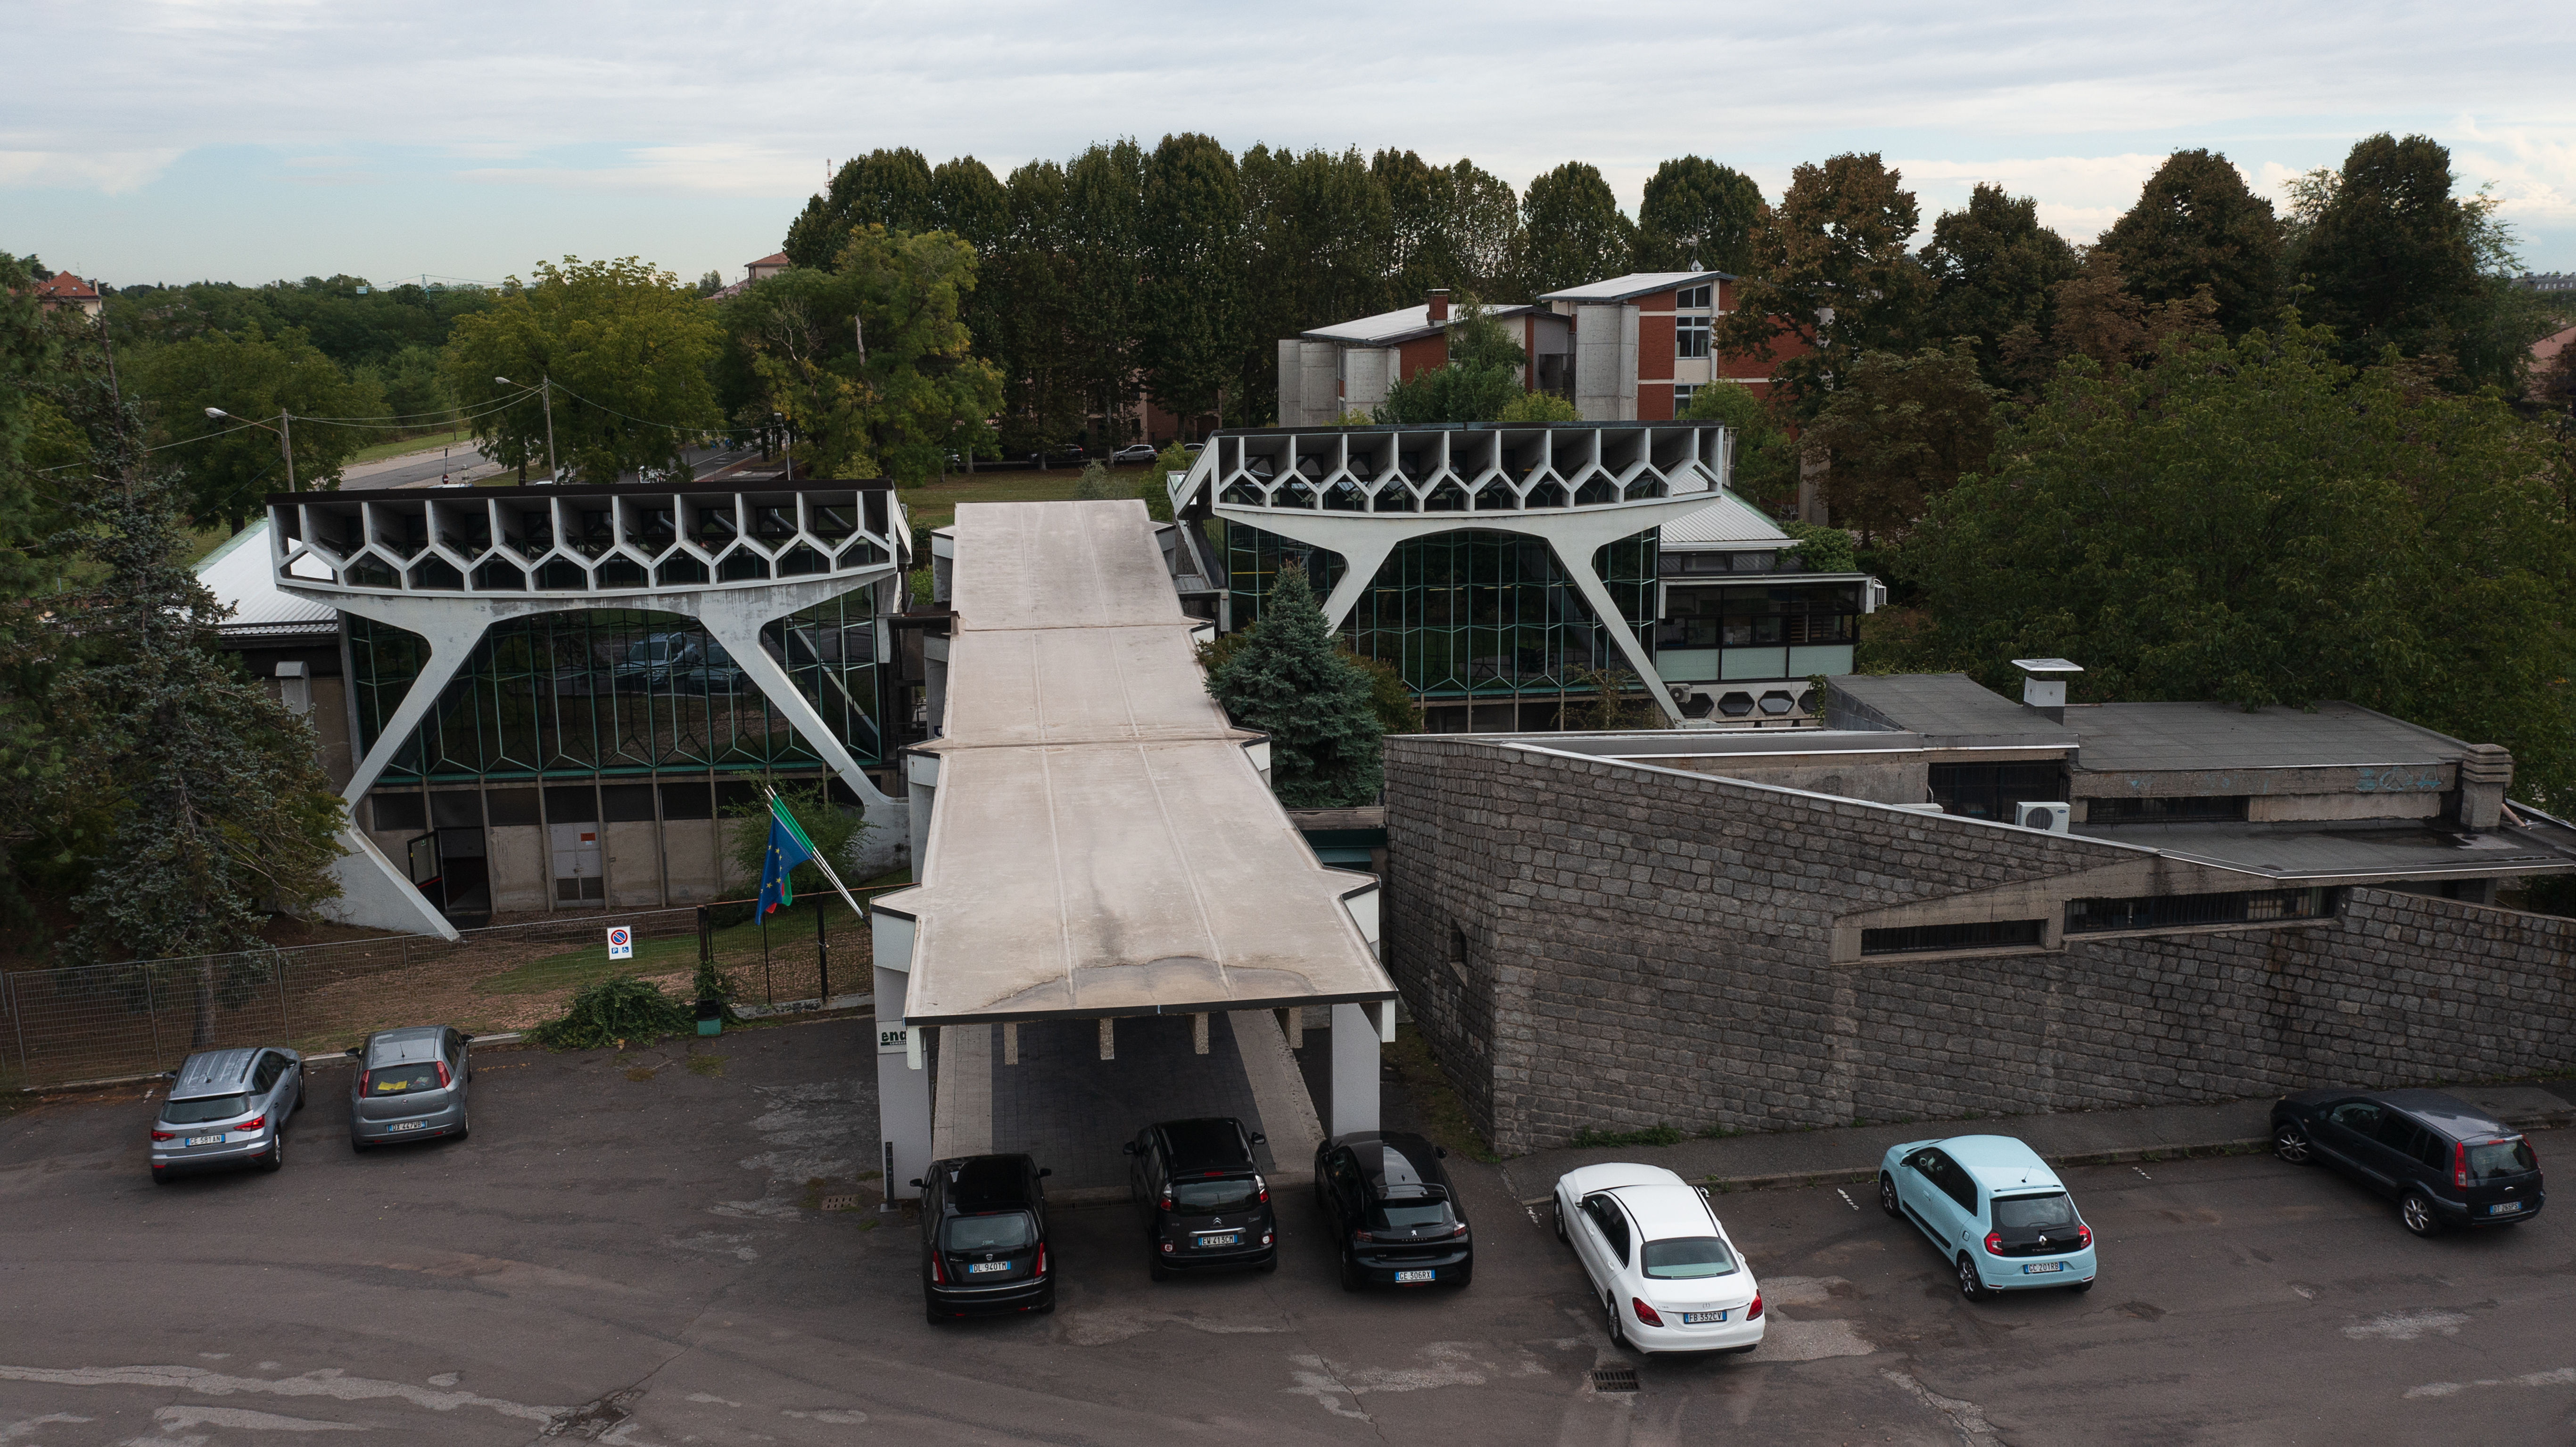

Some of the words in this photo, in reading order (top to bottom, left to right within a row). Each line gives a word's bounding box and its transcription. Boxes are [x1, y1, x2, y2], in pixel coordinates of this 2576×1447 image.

[882, 1031, 906, 1042] ena
[402, 1121, 421, 1129] 447WB
[200, 1135, 220, 1143] 581AN
[1213, 1235, 1233, 1243] 413CM
[985, 1262, 1006, 1271] 940TM
[2039, 1262, 2059, 1271] 201RB
[1410, 1271, 1430, 1279] 306RX
[1689, 1314, 1698, 1322] FB
[1700, 1312, 1721, 1321] 332CV
